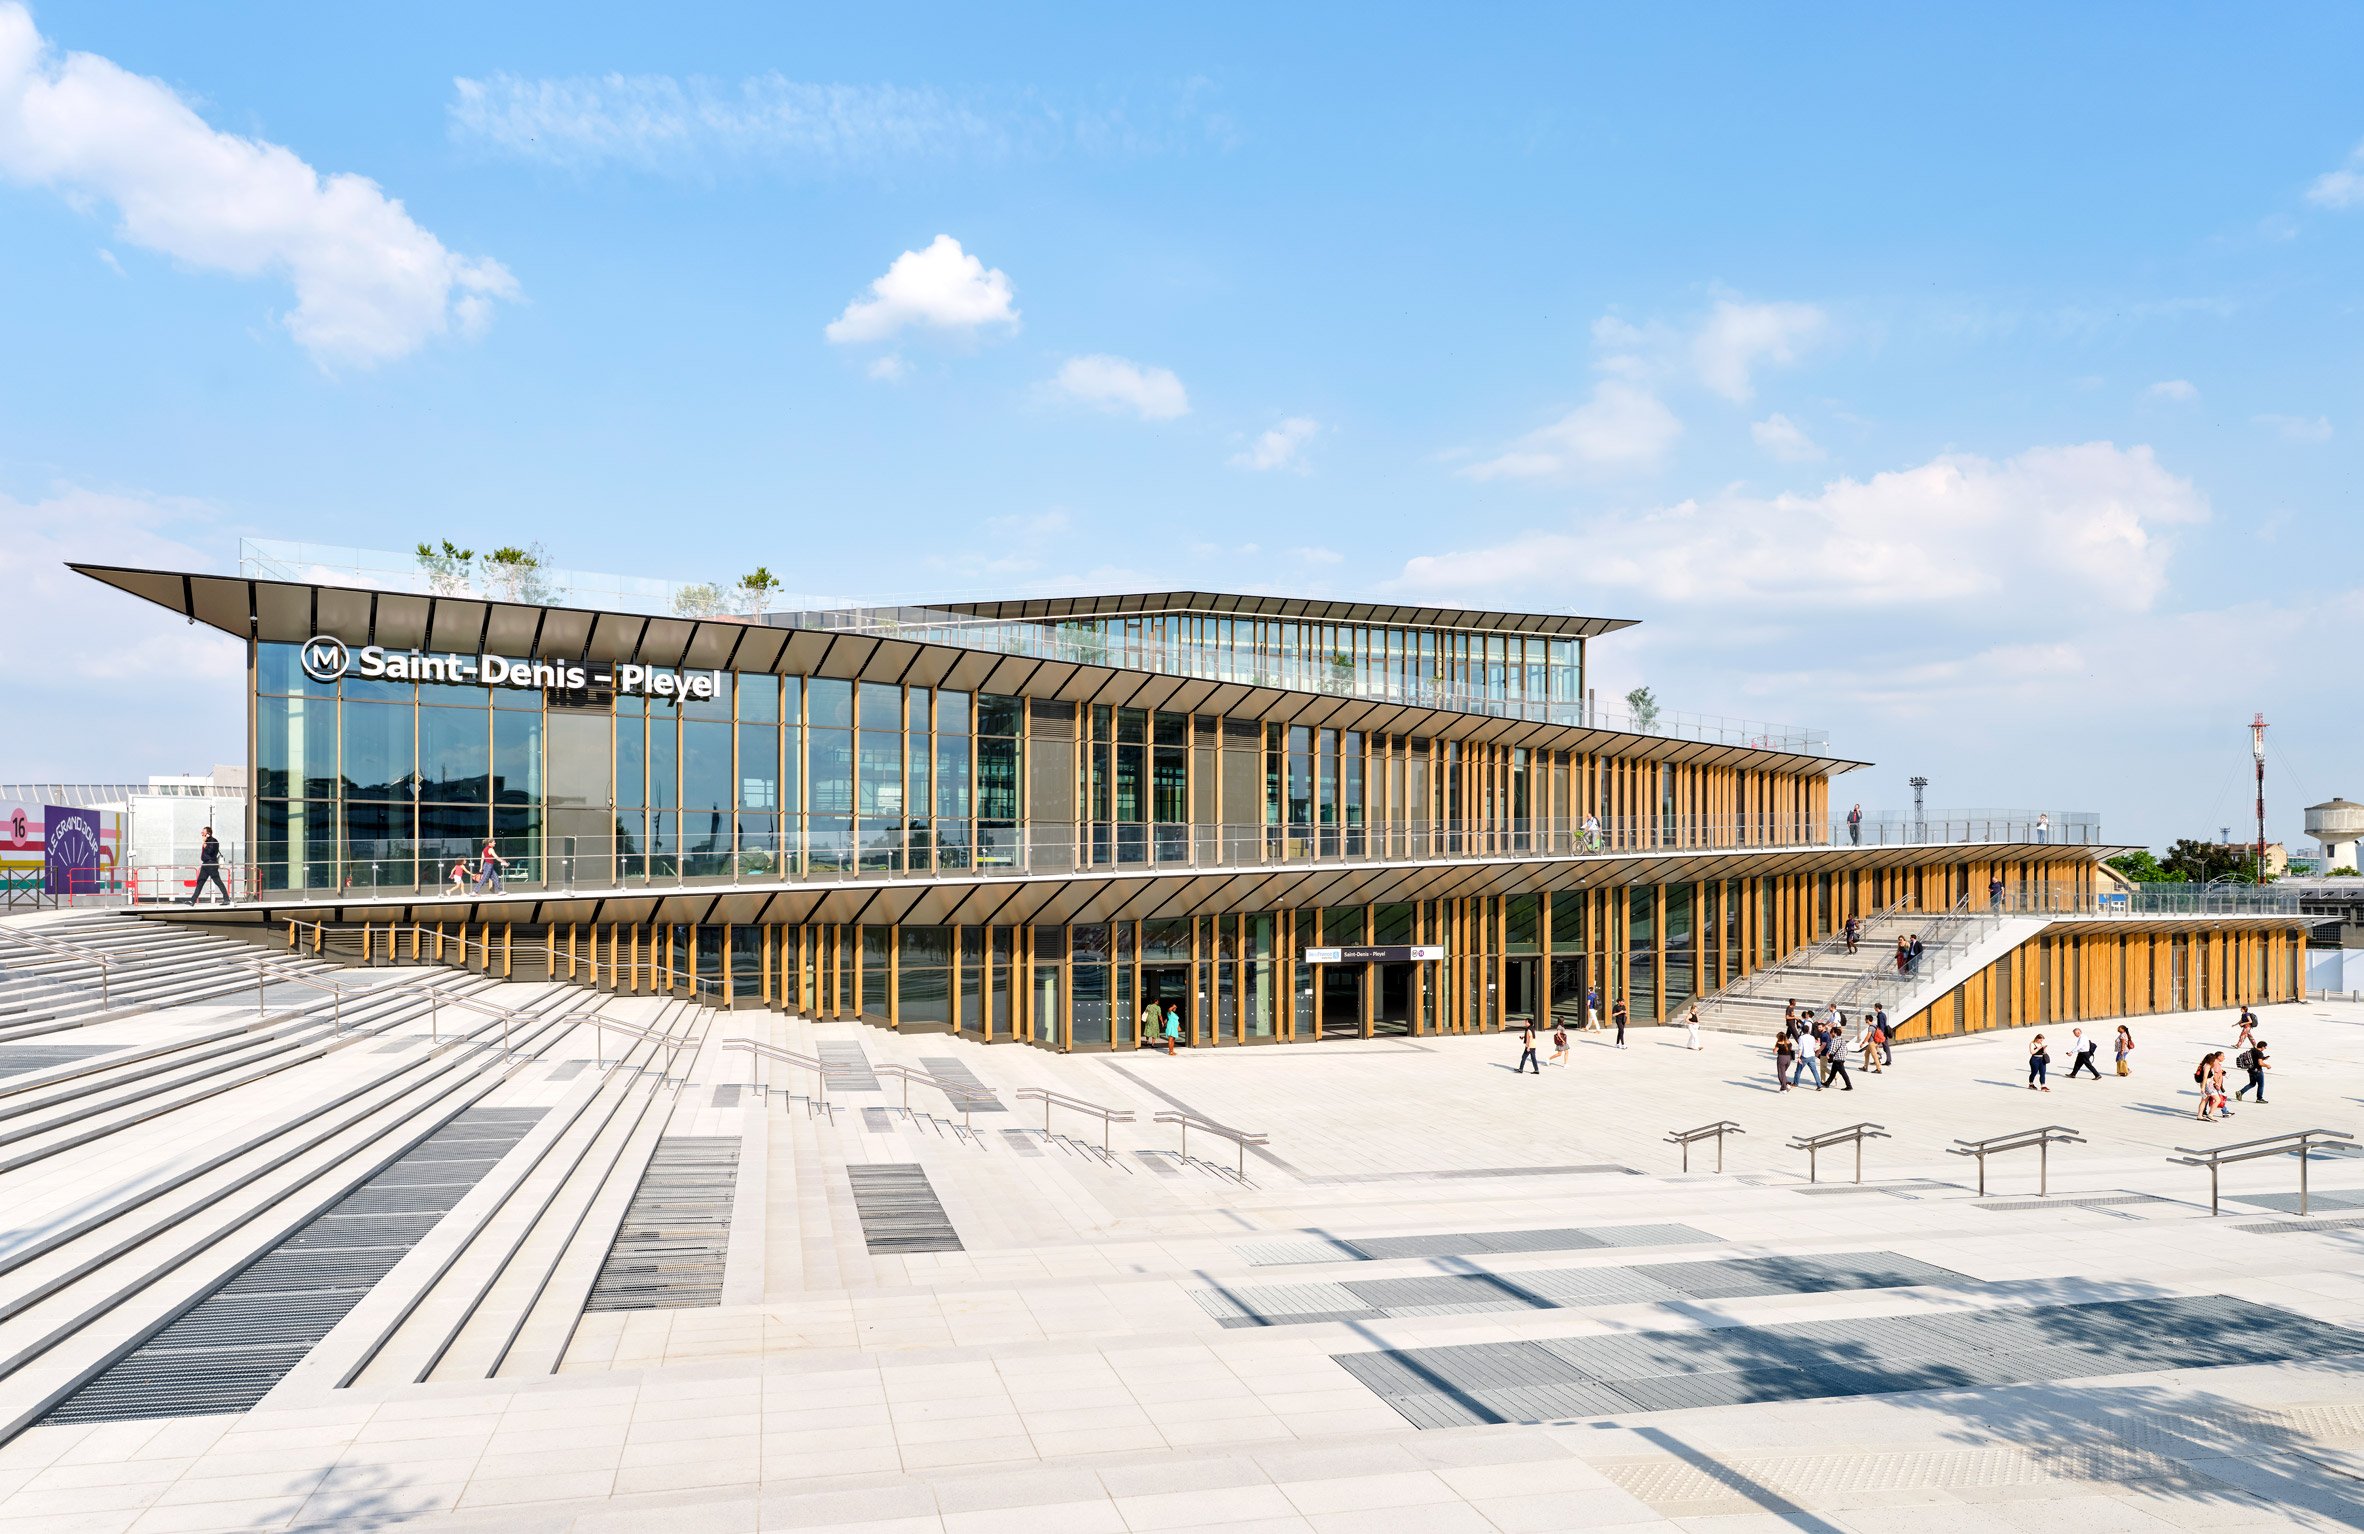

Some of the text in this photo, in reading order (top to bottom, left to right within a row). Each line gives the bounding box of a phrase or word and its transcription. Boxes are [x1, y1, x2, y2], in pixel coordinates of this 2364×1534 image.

[360, 645, 585, 689] Saint-Denis
[622, 664, 720, 703] Pleyel
[12, 816, 26, 838] 16
[47, 815, 99, 857] LE GRAND JOUR
